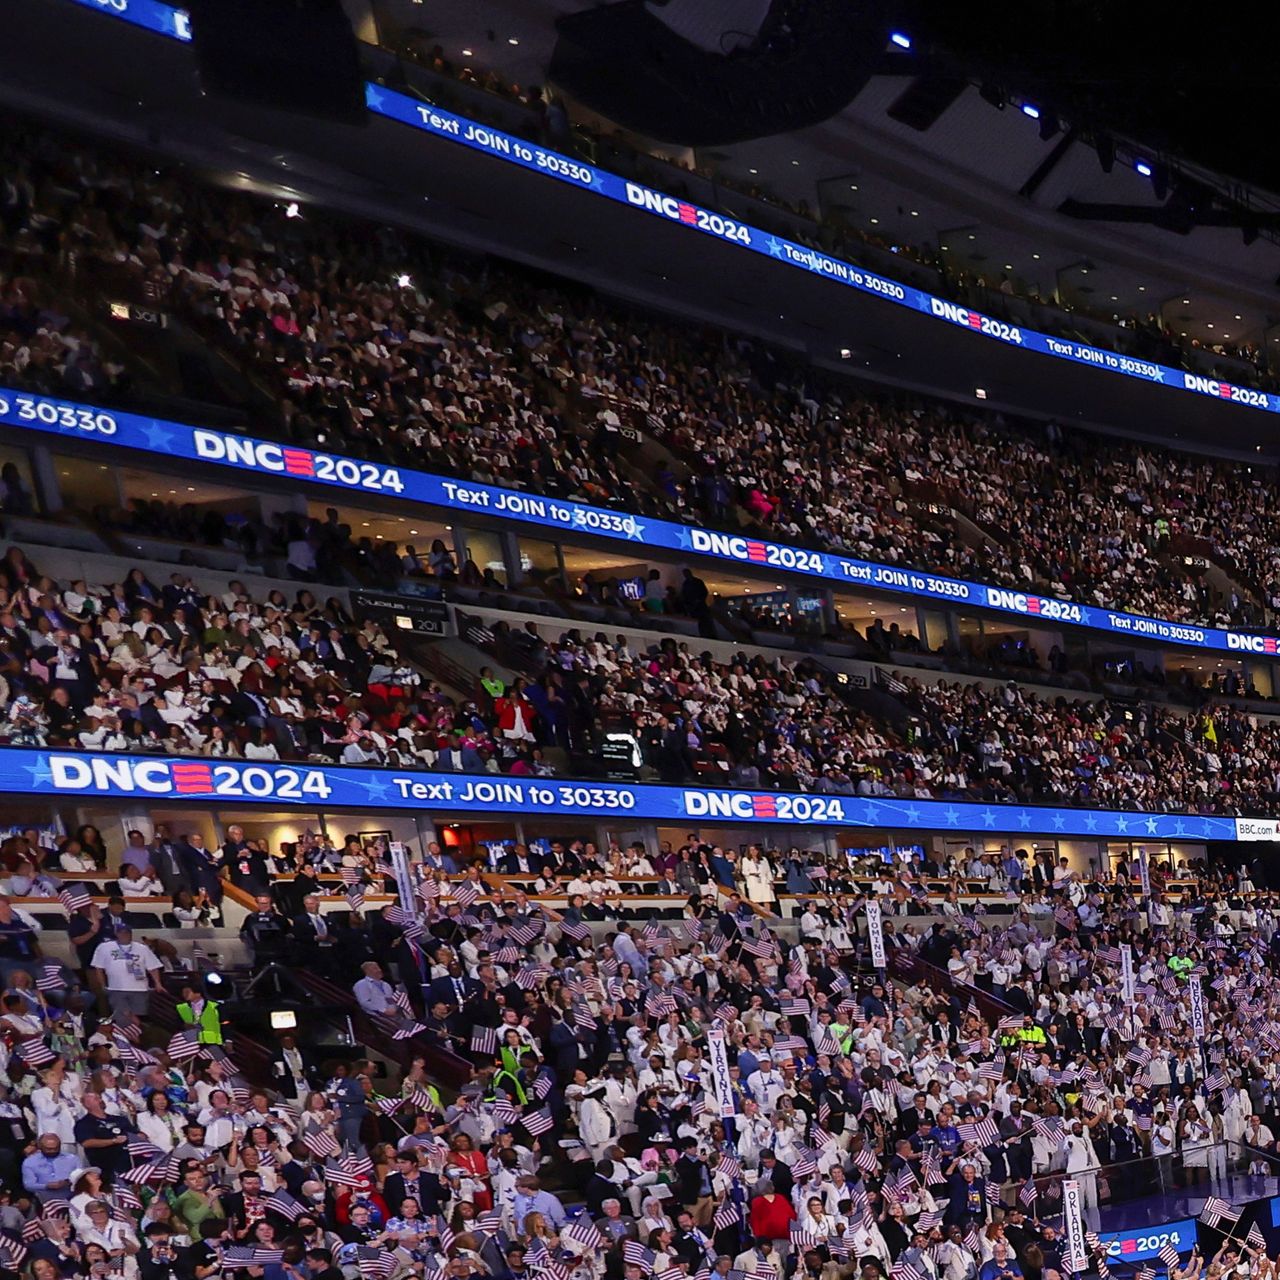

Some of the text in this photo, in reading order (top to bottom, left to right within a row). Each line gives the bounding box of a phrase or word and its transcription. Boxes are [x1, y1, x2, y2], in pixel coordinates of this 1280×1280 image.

[417, 106, 592, 184] Text JOIN to 30330
[625, 181, 751, 244] DNC 2024
[931, 298, 1022, 343] DNC 2024
[1184, 374, 1269, 409] DNC 2024
[16, 397, 117, 436] 30330
[193, 429, 404, 494] DNC 2024
[442, 481, 637, 536] Text JOIN to 30330
[691, 529, 824, 575] DNC 2024
[418, 619, 439, 631] 201
[988, 588, 1081, 623] DNC 2024
[48, 755, 331, 799] DNC 2024
[393, 778, 635, 809] Text JOIN to 30330
[684, 791, 845, 821] DNC 2024
[1240, 823, 1273, 835] BBC.com
[867, 907, 882, 957] WYOMING
[1191, 981, 1203, 1028] NEVADA
[712, 1040, 729, 1106] VIRGINIA
[1068, 1190, 1082, 1259] OKLAHOMA
[1137, 1231, 1181, 1250] 2024
